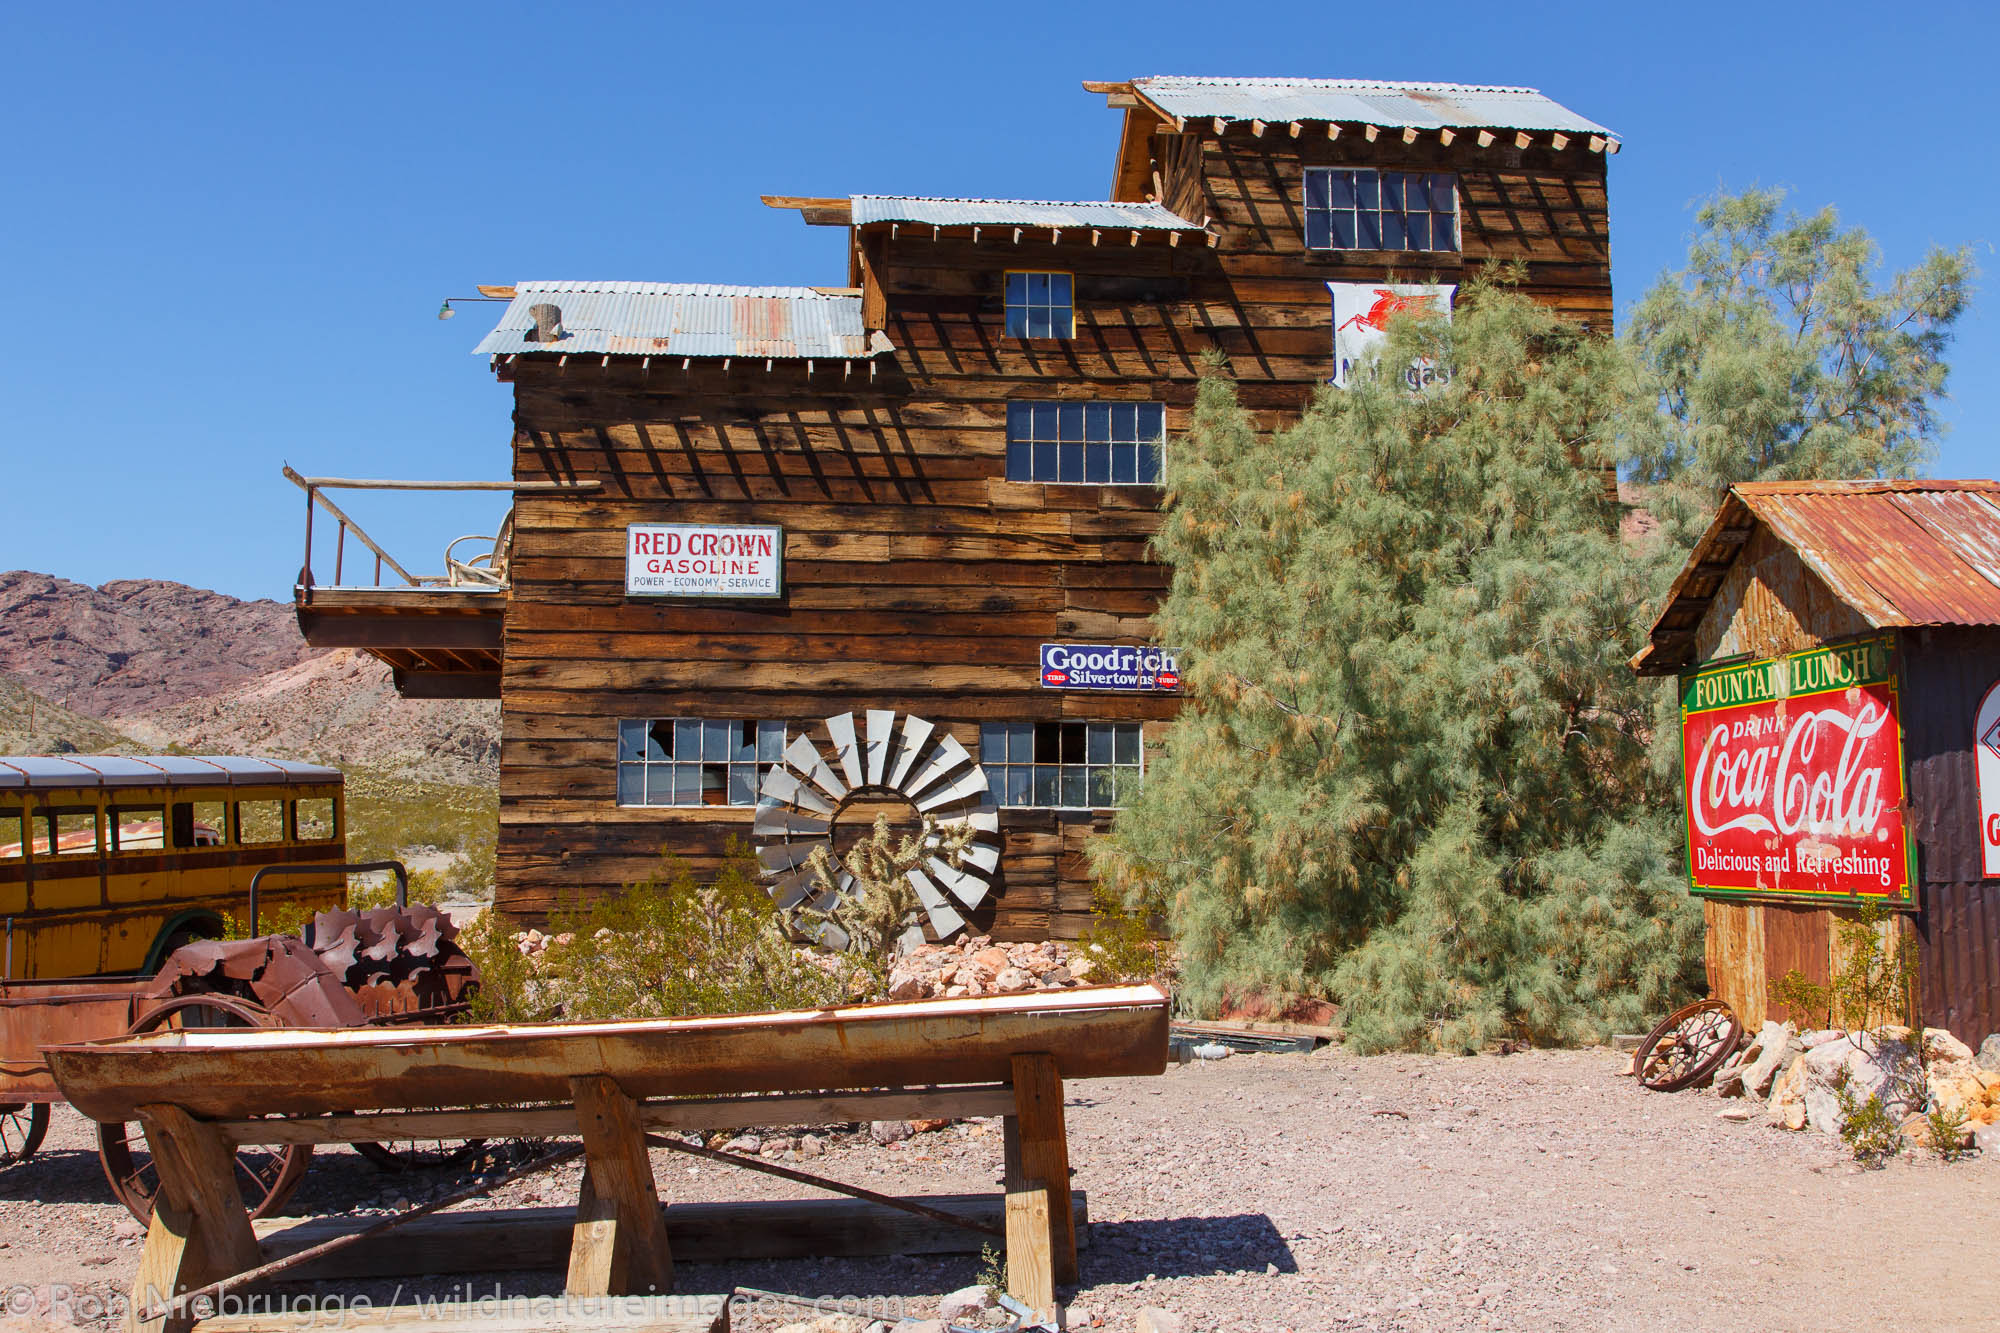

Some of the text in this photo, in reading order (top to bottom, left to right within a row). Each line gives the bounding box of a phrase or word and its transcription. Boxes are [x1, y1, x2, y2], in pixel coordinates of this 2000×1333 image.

[1342, 358, 1449, 391] Mgas
[634, 532, 772, 557] RED CROWN
[647, 559, 760, 575] GASOLINE
[634, 577, 664, 586] POWER
[674, 577, 719, 587] ECONOMY
[728, 578, 771, 588] SERVICE
[1046, 647, 1178, 672] Goodrich
[1069, 669, 1154, 685] Silvertowns
[1695, 647, 1872, 708] FOUNTAIN LUNCH
[1732, 715, 1786, 739] DRINK
[1692, 701, 1891, 836] Coca-Cola
[1697, 847, 1890, 887] Delicious and Refreshing
